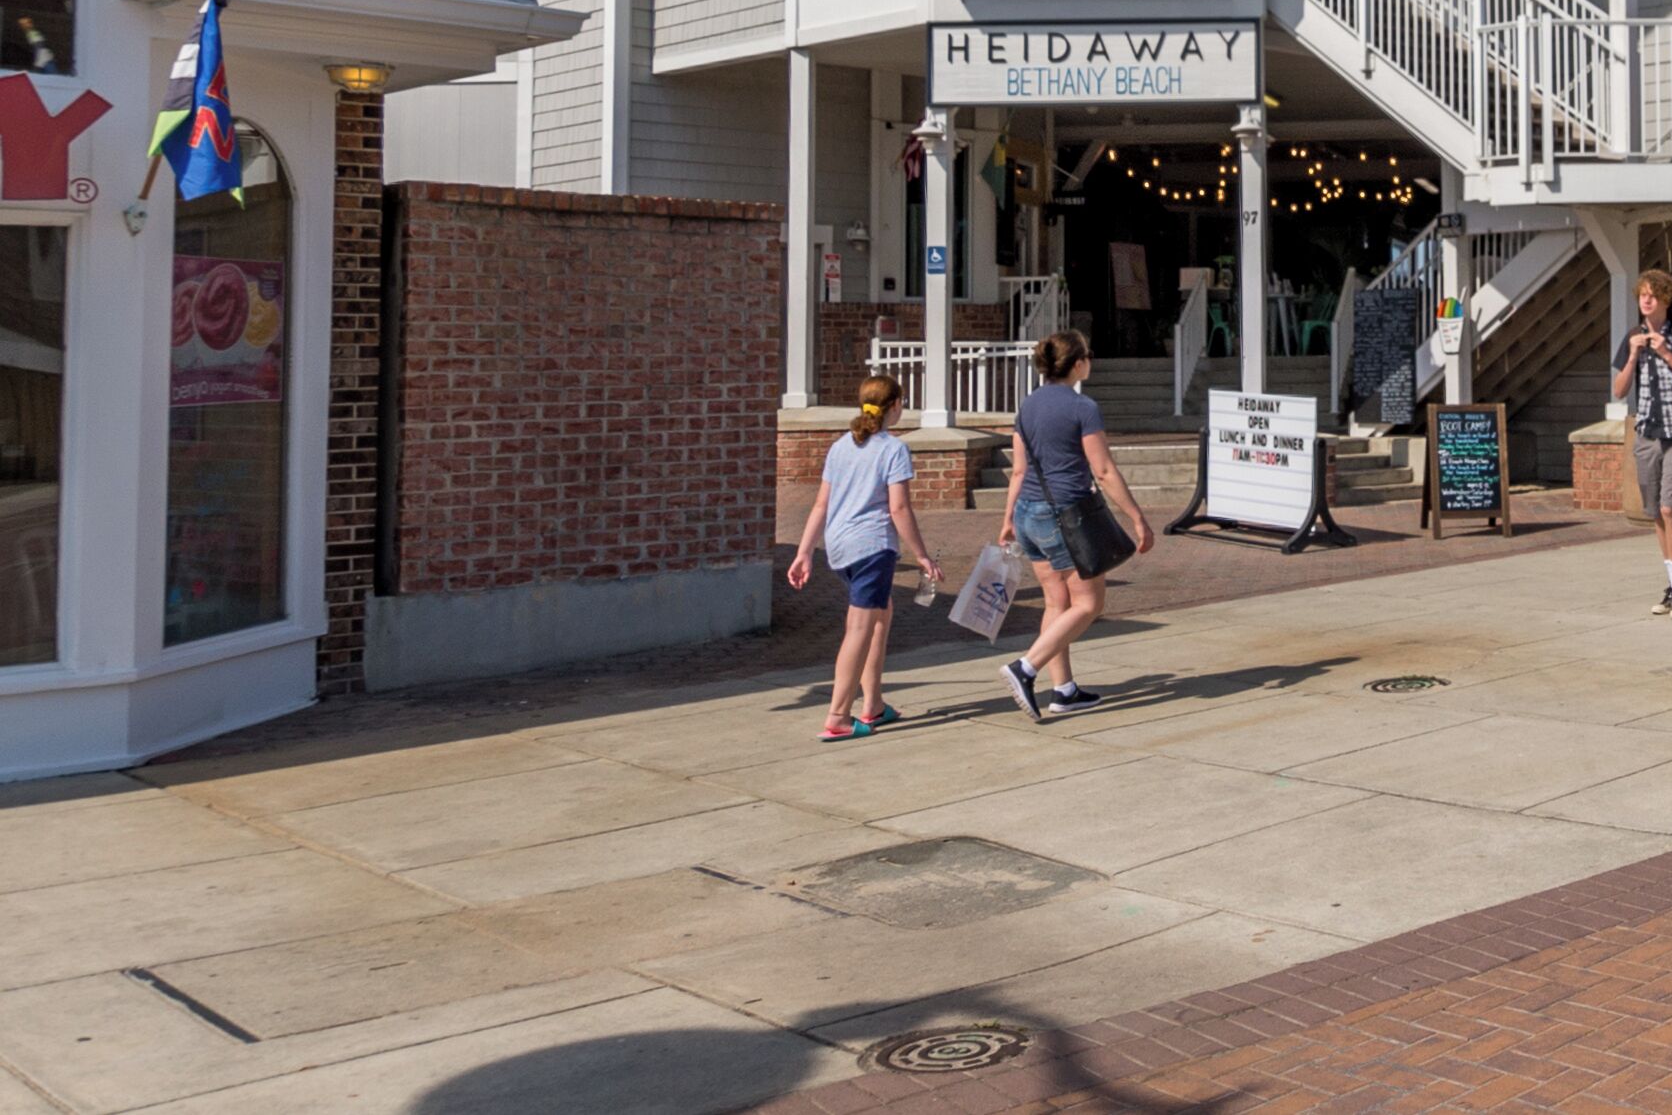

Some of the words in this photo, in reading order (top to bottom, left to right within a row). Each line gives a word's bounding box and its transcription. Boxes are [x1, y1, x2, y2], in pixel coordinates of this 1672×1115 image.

[947, 29, 1241, 64] HEIDAWAY
[1007, 66, 1107, 96] BETHANY
[1115, 65, 1182, 95] BEACH
[1243, 211, 1258, 226] 97
[1238, 397, 1281, 413] HEIDAWAY
[1248, 415, 1270, 430] OPEN
[1440, 420, 1462, 432] BOOT
[1219, 429, 1246, 445] LUNCH
[1252, 433, 1268, 447] AND
[1273, 435, 1305, 451] DINNER
